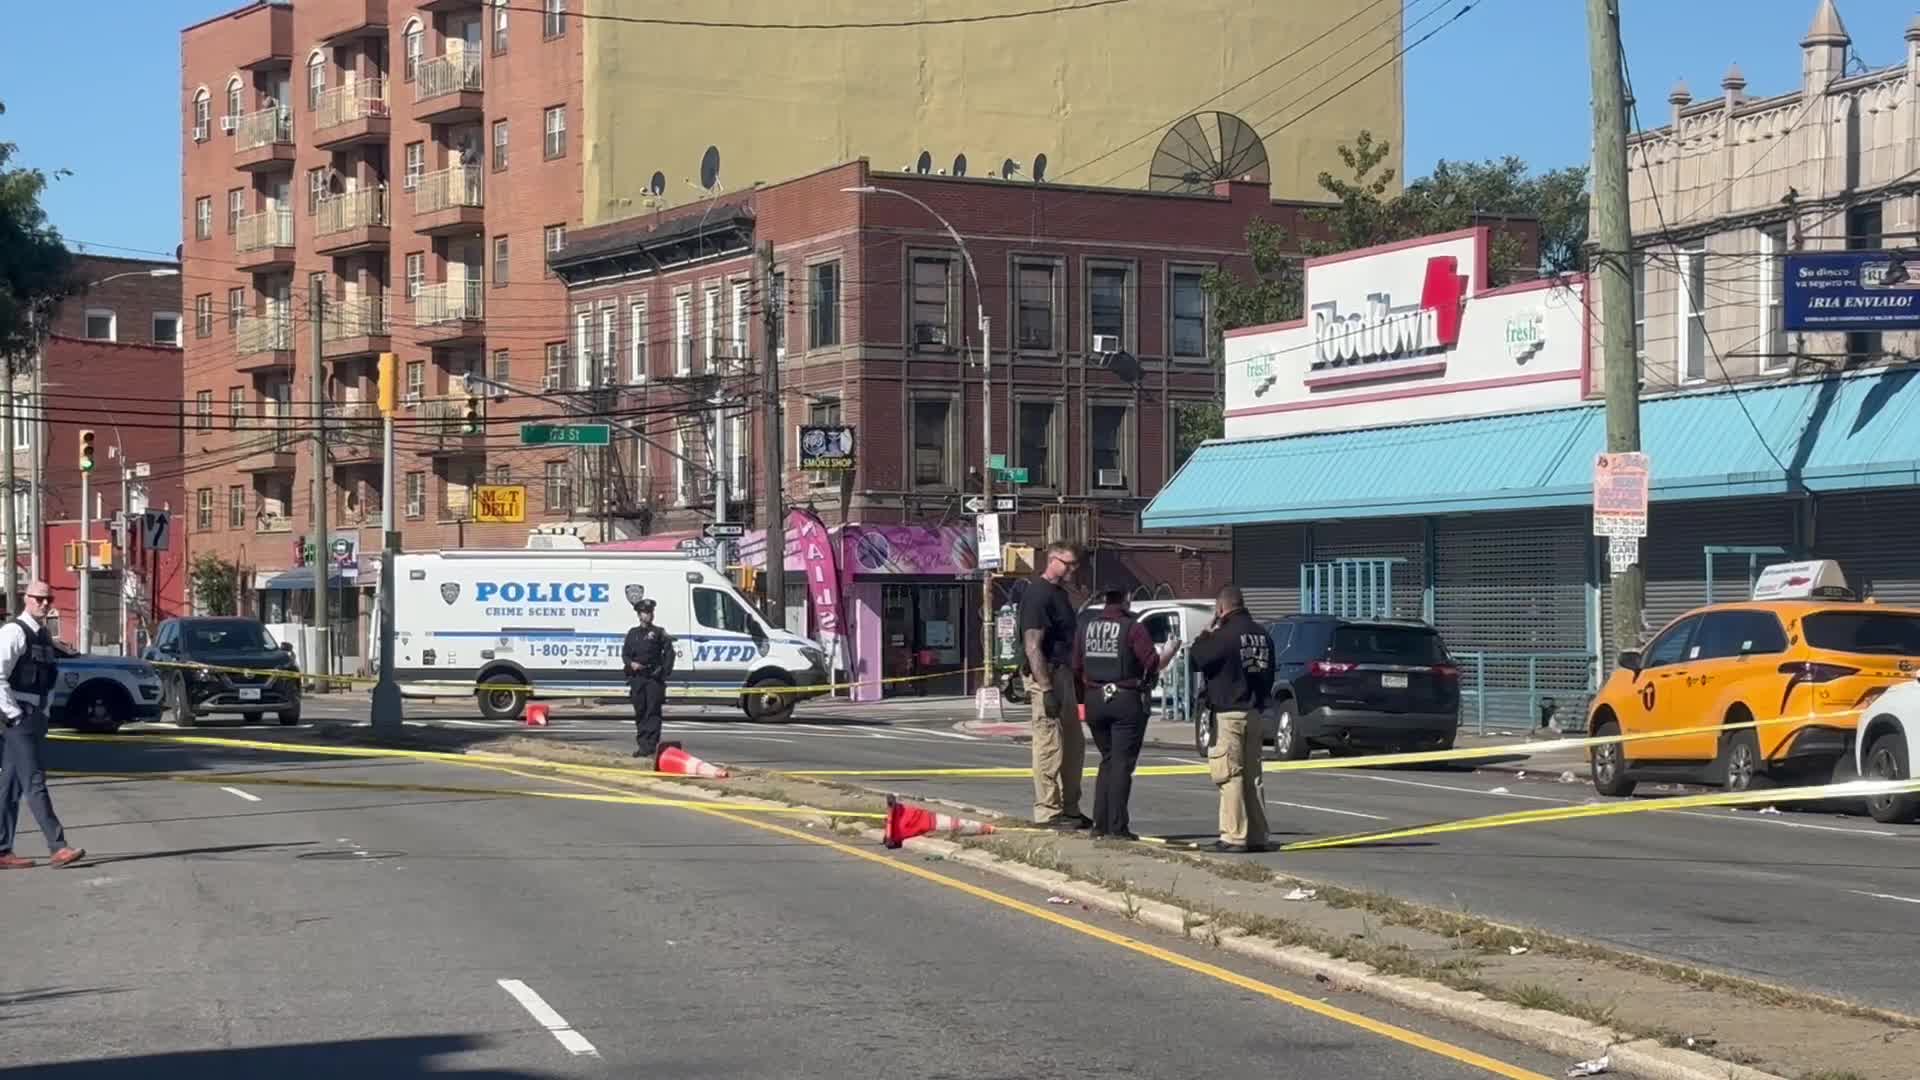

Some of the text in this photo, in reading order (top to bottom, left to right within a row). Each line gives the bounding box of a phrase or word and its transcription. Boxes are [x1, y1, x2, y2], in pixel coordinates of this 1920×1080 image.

[1313, 297, 1440, 363] Foodtown
[1505, 317, 1538, 343] fresh
[1246, 358, 1272, 378] fresh
[803, 457, 853, 467] SMOKE SHOP
[481, 502, 515, 517] DELI
[475, 582, 610, 602] POLICE
[485, 607, 600, 616] CRIME SCENE UNIT
[1086, 622, 1120, 639] NYPD
[694, 645, 756, 662] NYPD
[1085, 639, 1118, 652] POLICE
